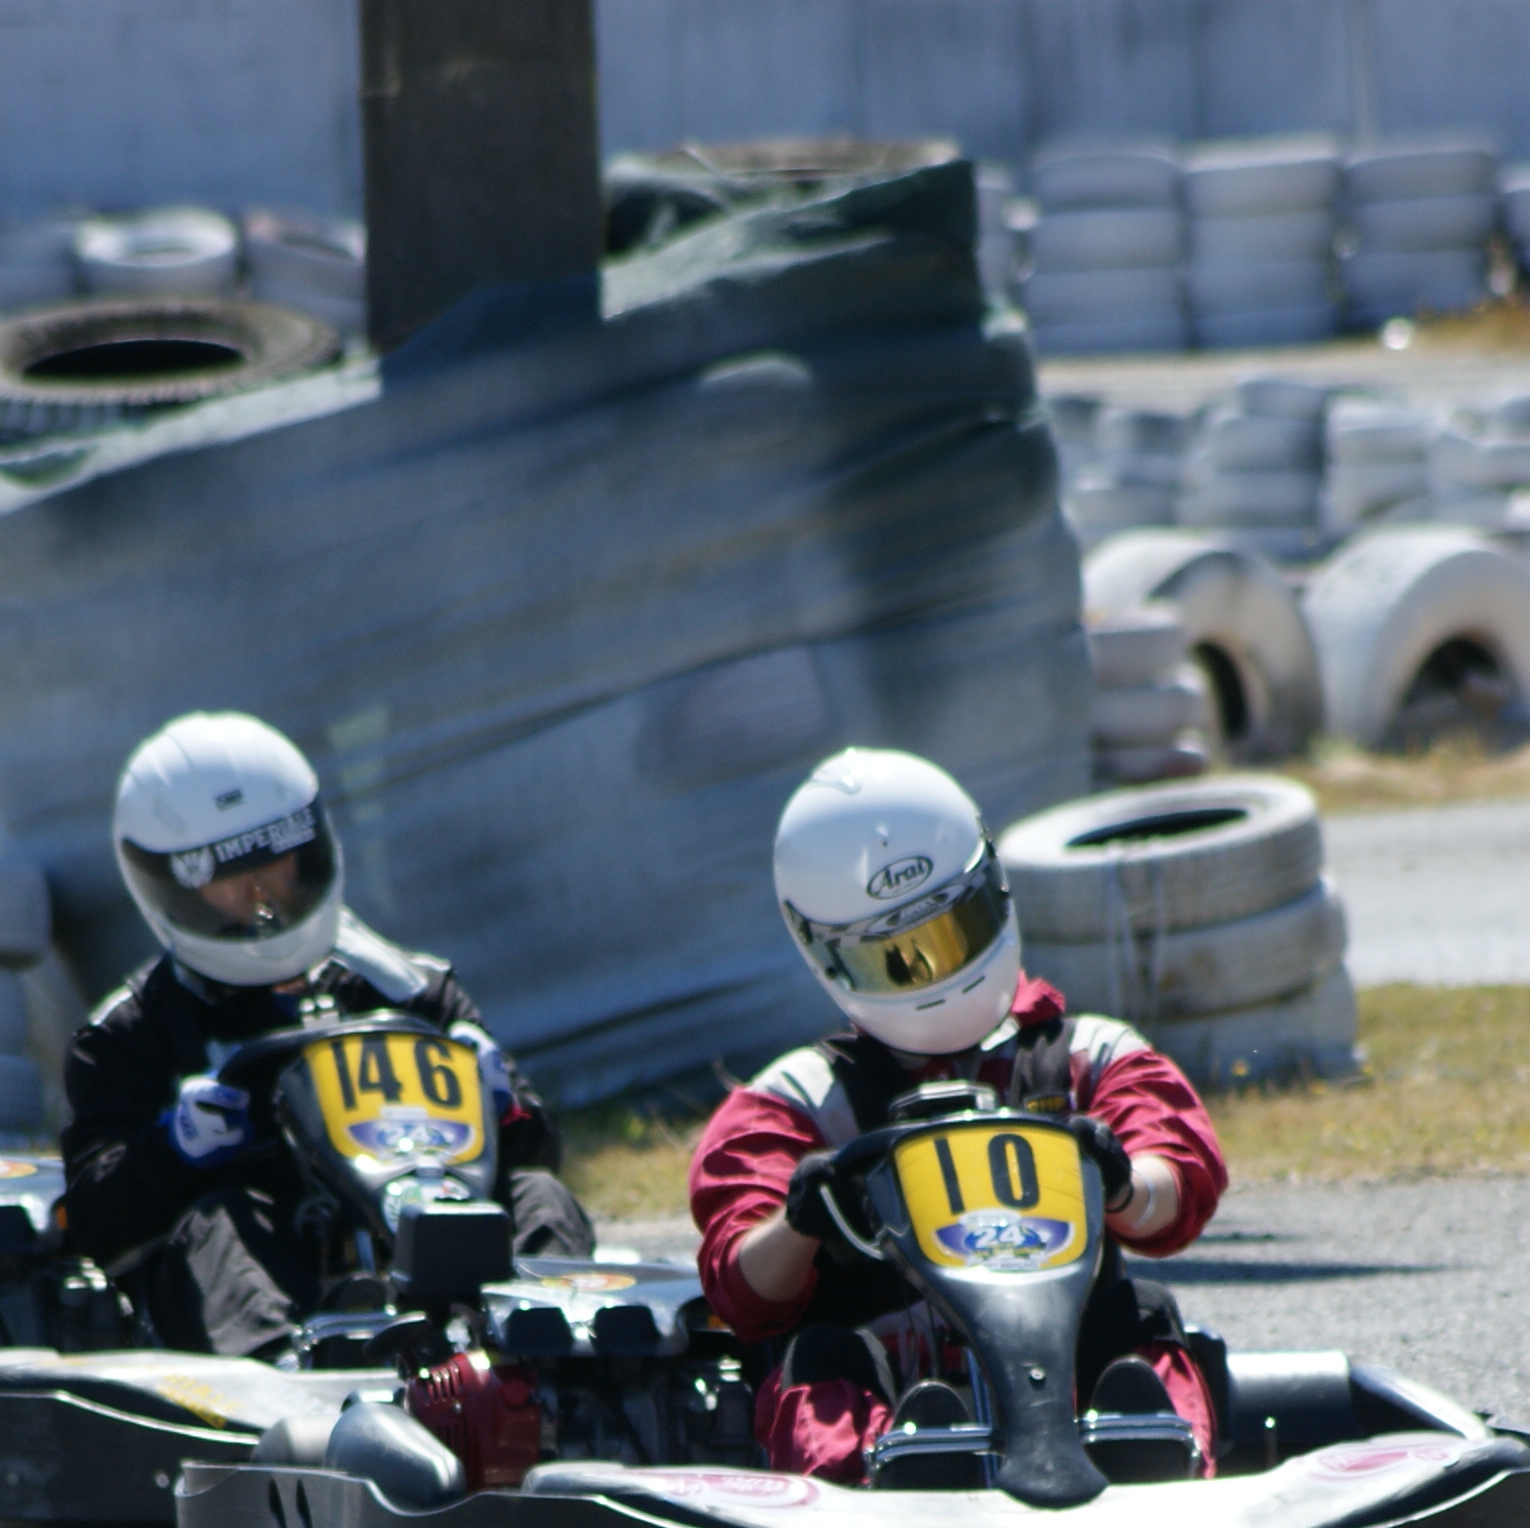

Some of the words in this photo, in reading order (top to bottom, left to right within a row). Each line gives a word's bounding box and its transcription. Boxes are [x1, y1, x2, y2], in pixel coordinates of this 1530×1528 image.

[215, 807, 316, 864] IMPERIALE
[876, 859, 925, 893] Arai
[330, 1035, 463, 1111] 146
[933, 1133, 1040, 1215] 10
[973, 1225, 1026, 1249] 24
